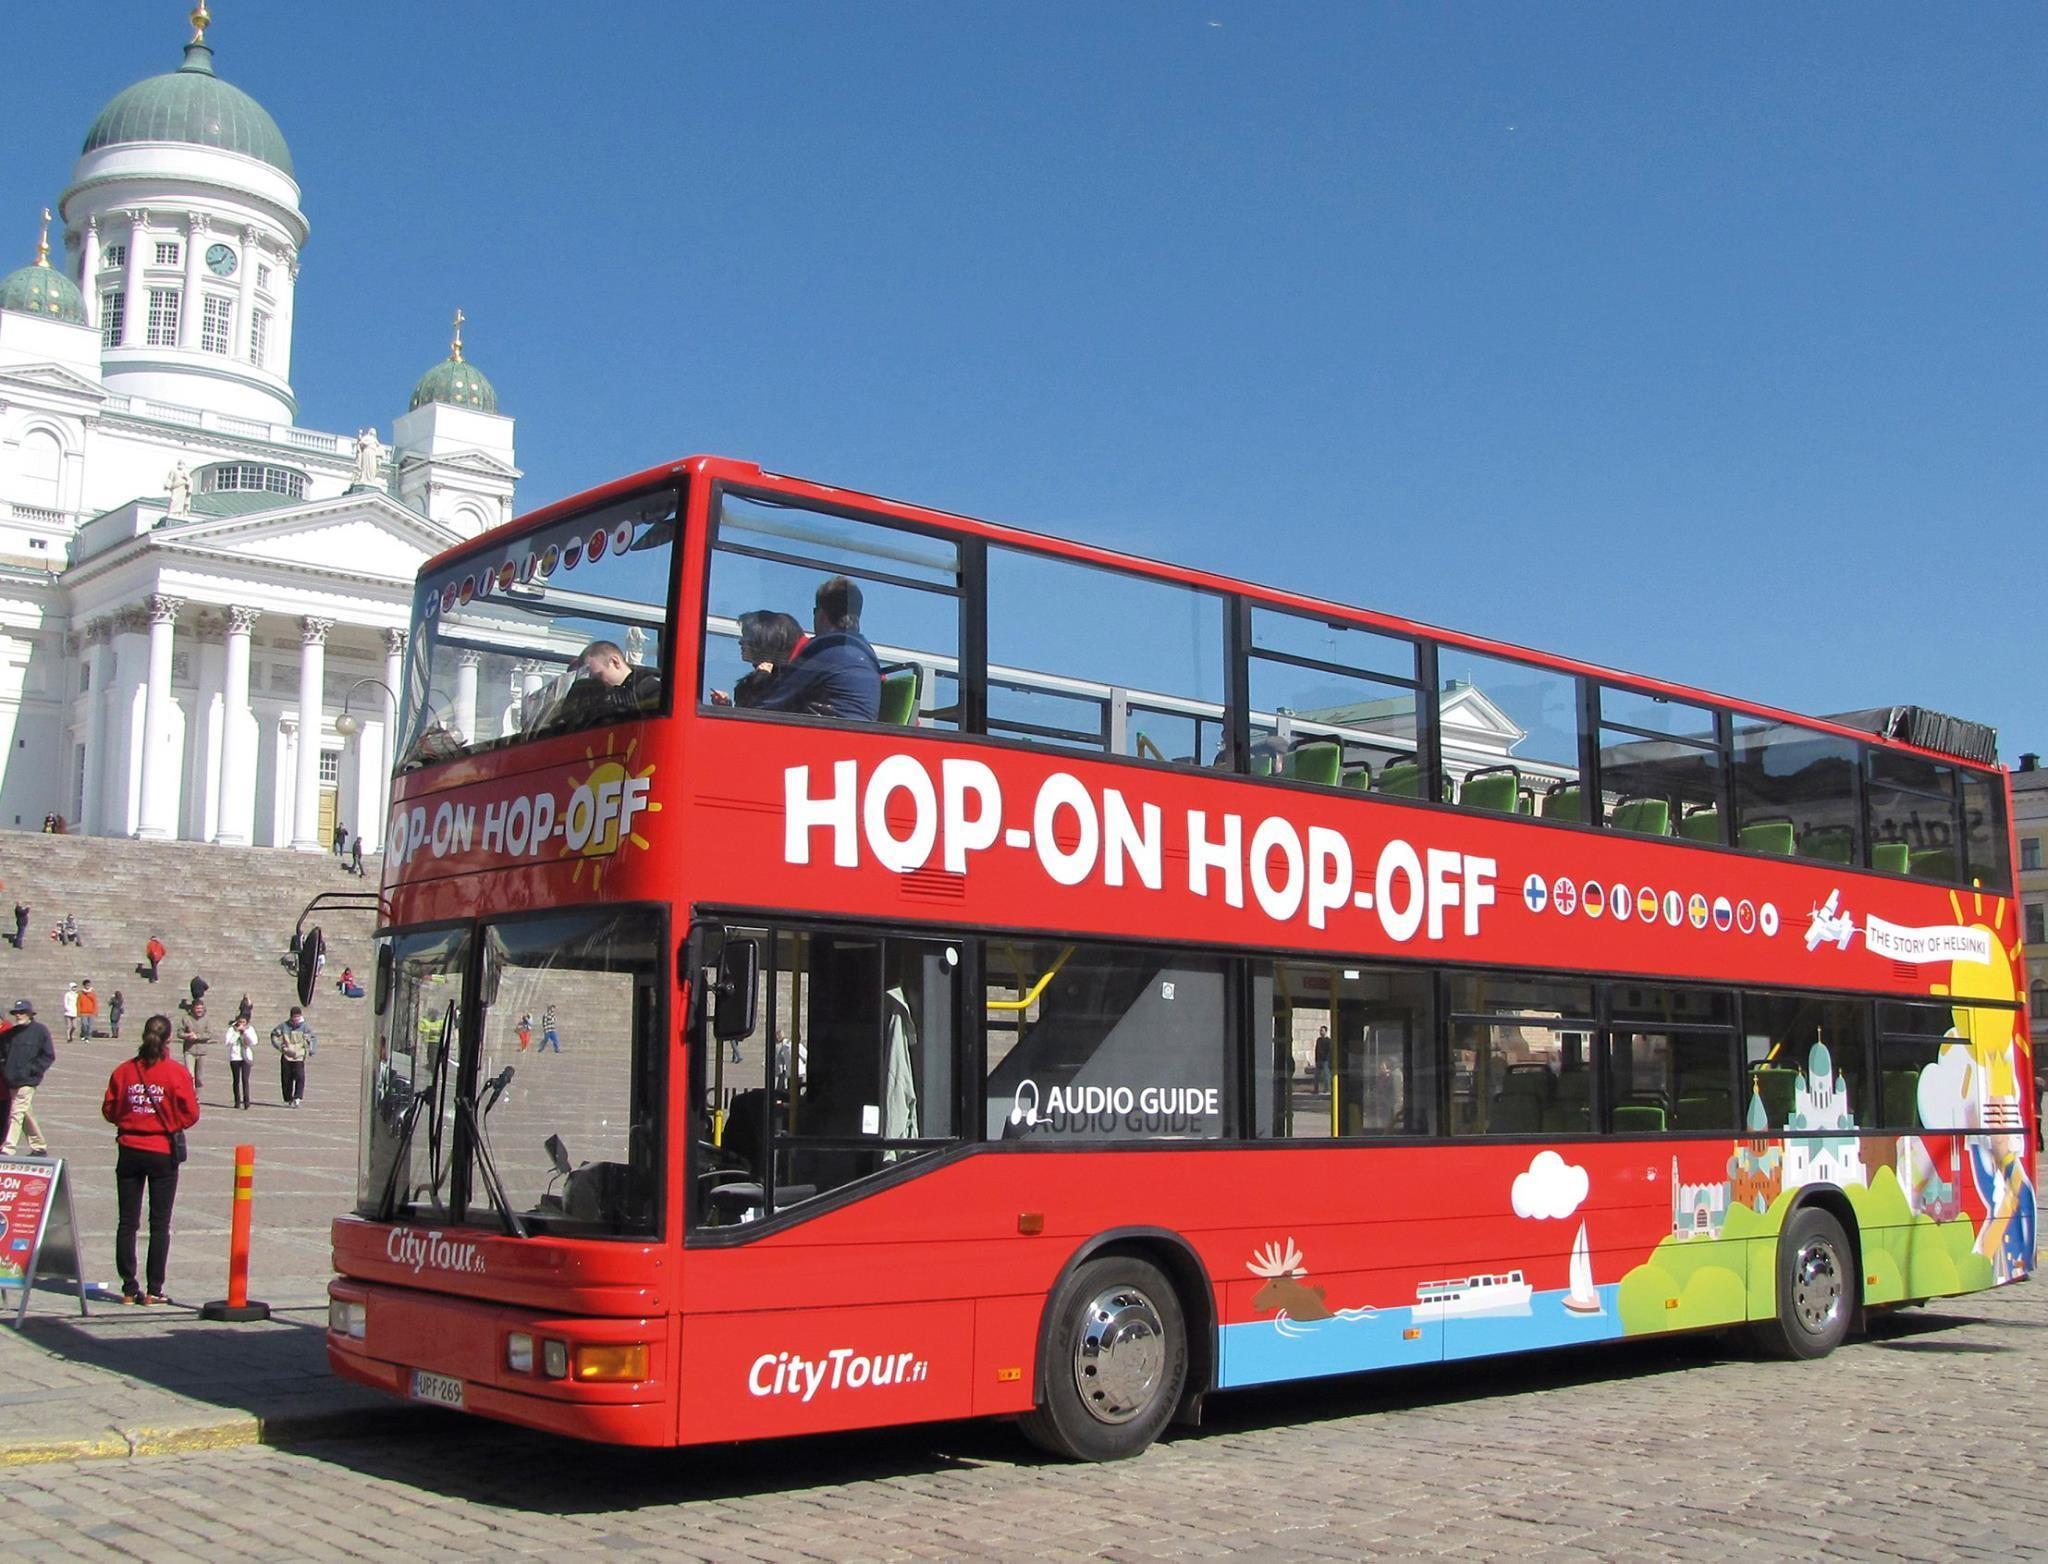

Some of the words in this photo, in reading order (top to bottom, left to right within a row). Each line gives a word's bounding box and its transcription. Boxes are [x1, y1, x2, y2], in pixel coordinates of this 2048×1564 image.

[482, 778, 651, 857] HOP-OFF
[784, 754, 1163, 890] HOP-ON
[1186, 810, 1498, 942] HOP-OFF
[1870, 927, 1891, 949] THE
[1893, 936, 1925, 954] STORY
[1927, 937, 1941, 952] OF
[1943, 936, 1986, 955] HELSINKI
[1046, 1086, 1134, 1114] AUDIO
[1140, 1087, 1219, 1115] GUIDE
